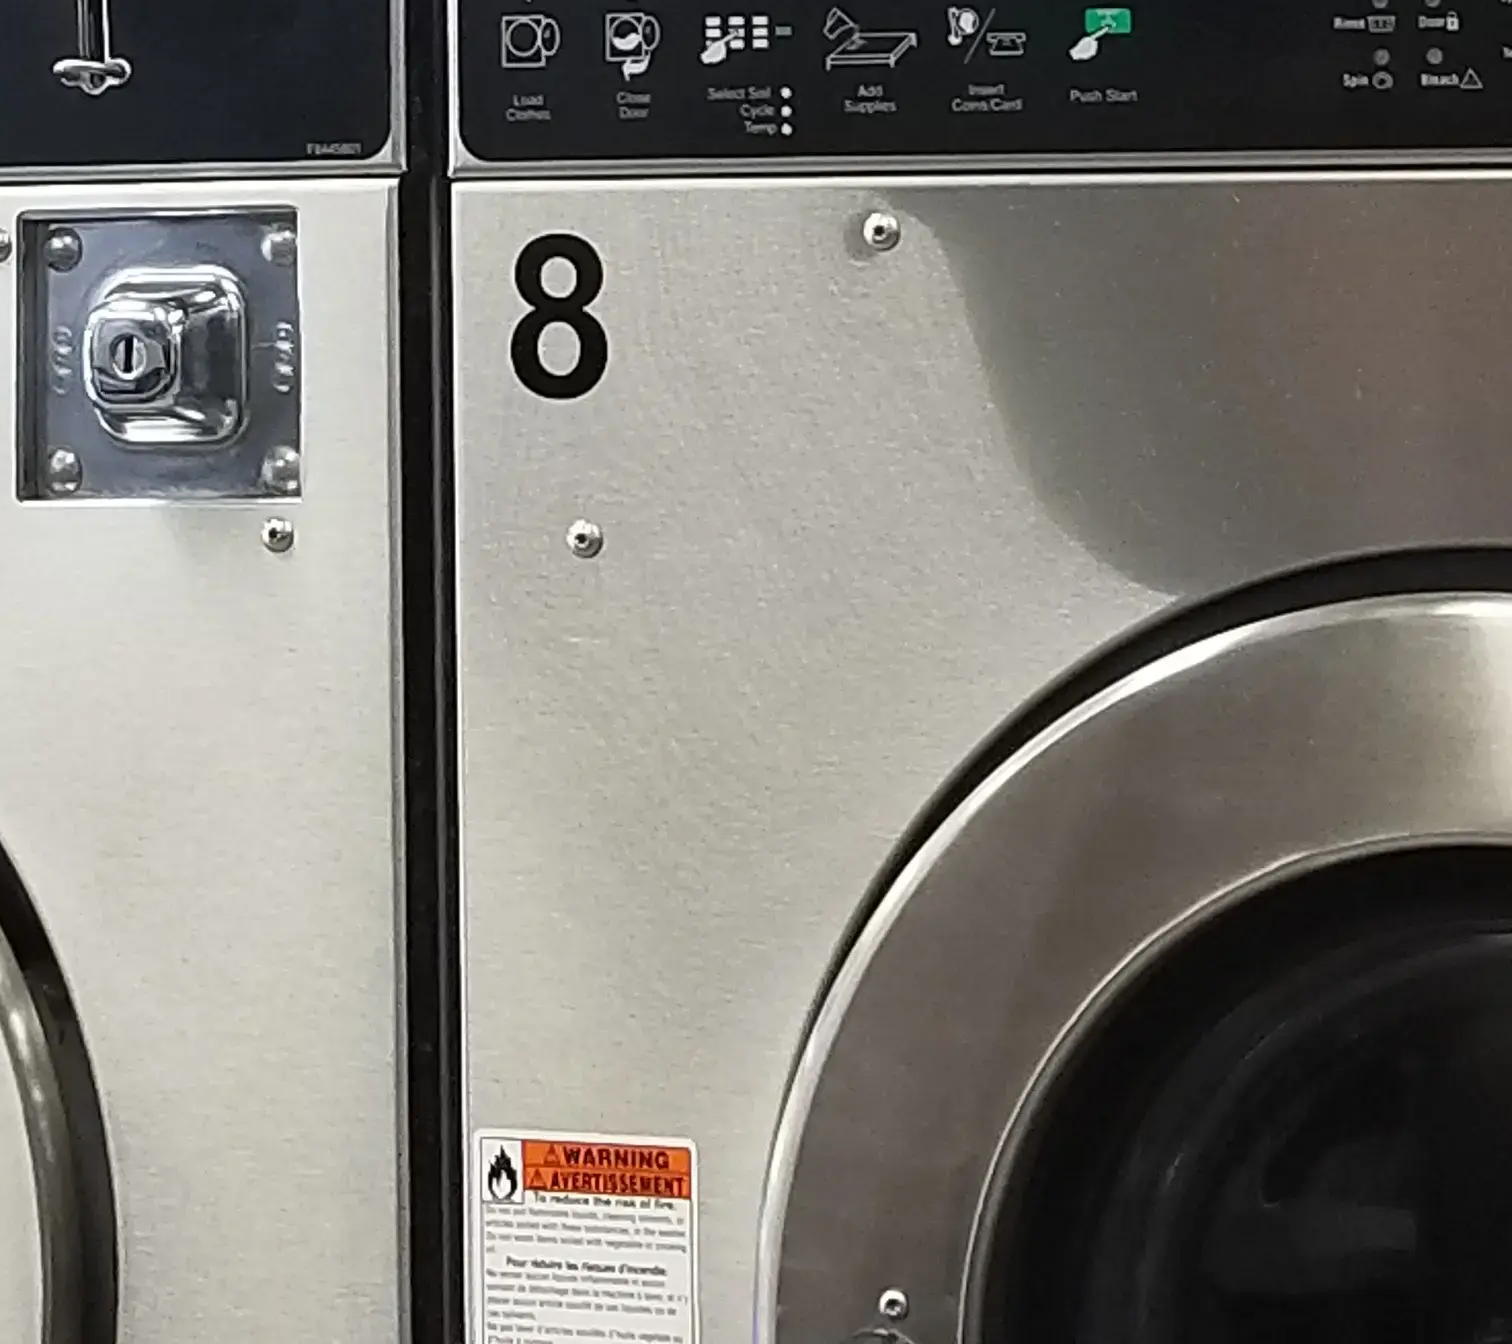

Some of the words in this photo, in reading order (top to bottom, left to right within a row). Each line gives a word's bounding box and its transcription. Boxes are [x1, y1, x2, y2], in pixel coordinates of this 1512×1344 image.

[1069, 88, 1103, 103] Push
[510, 233, 609, 400] 8
[562, 1145, 671, 1170] WARNING
[550, 1169, 684, 1197] AVERTISSEMENT
